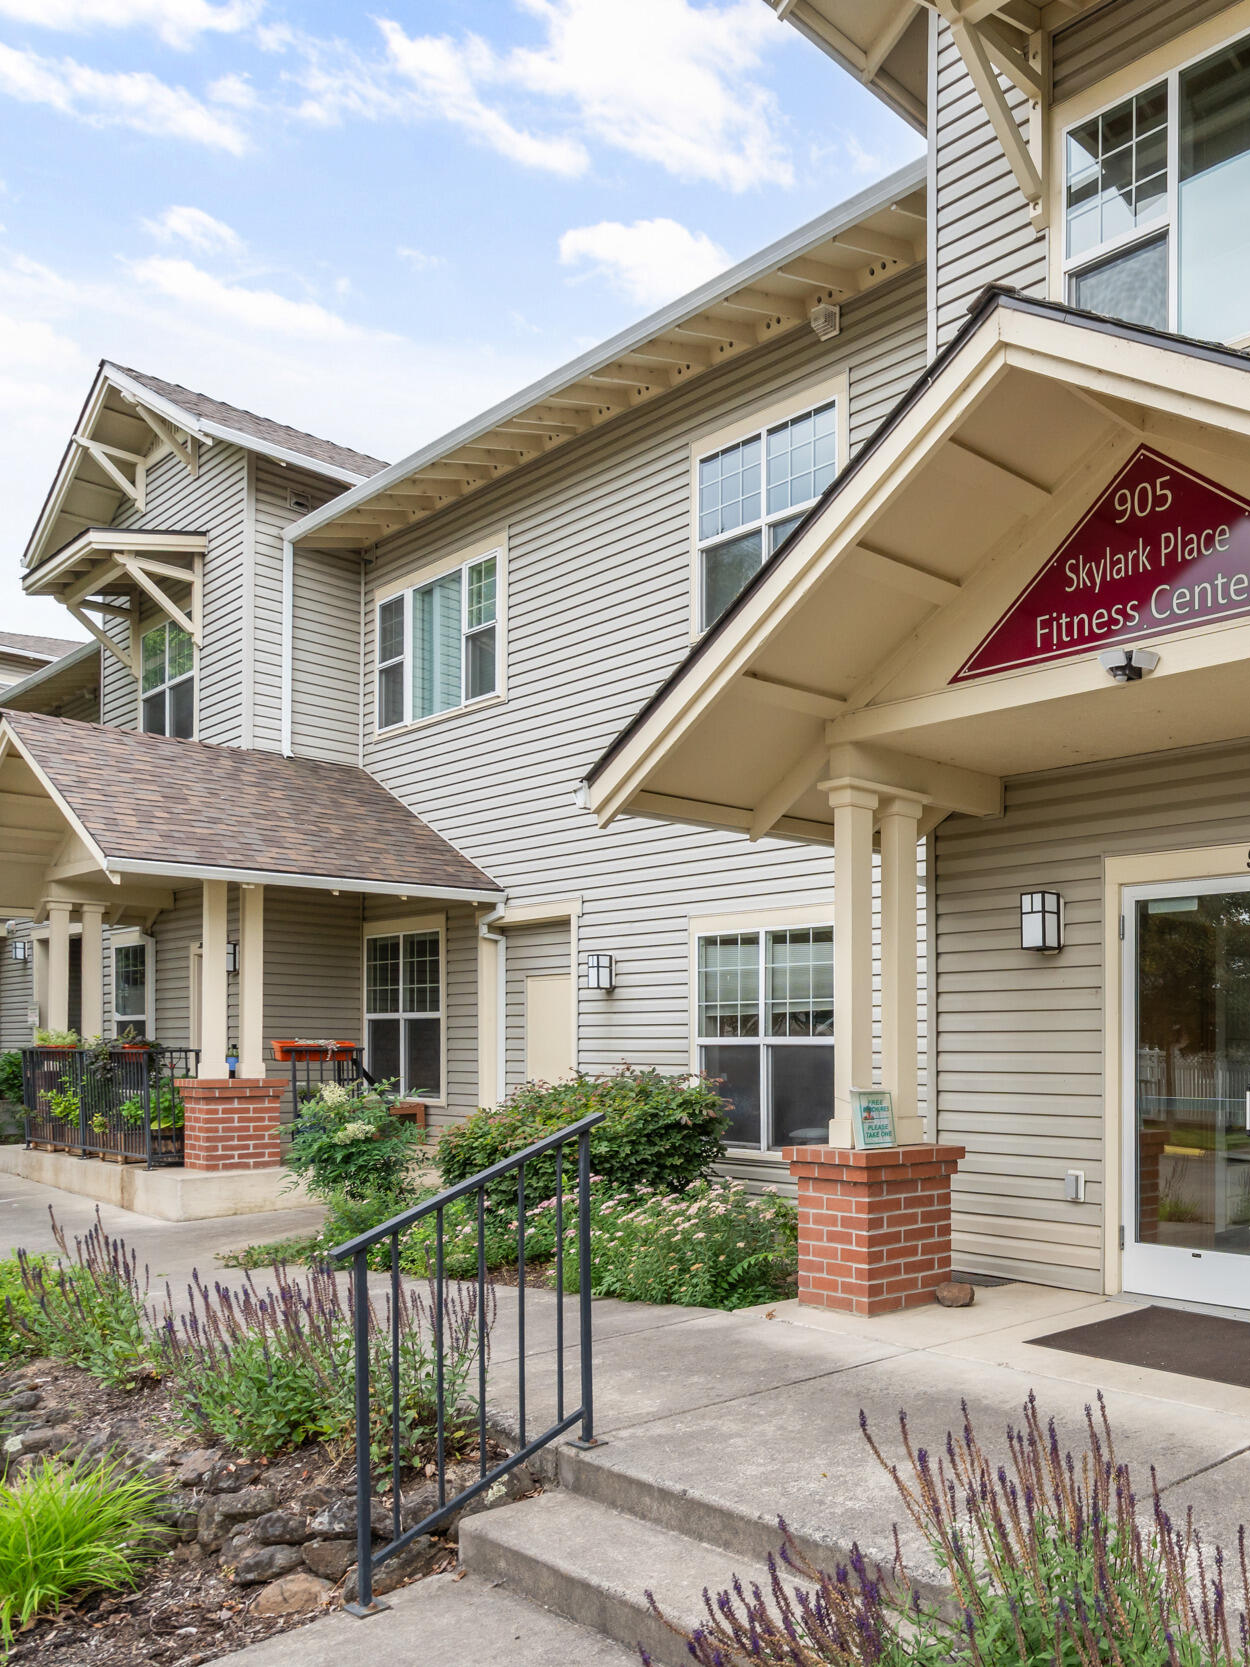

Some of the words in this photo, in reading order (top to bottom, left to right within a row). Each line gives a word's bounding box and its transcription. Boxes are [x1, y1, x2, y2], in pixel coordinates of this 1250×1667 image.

[1114, 475, 1173, 525] 905
[1065, 538, 1152, 594] Skylark
[1161, 523, 1230, 567] Place
[1036, 600, 1139, 649] Fitness
